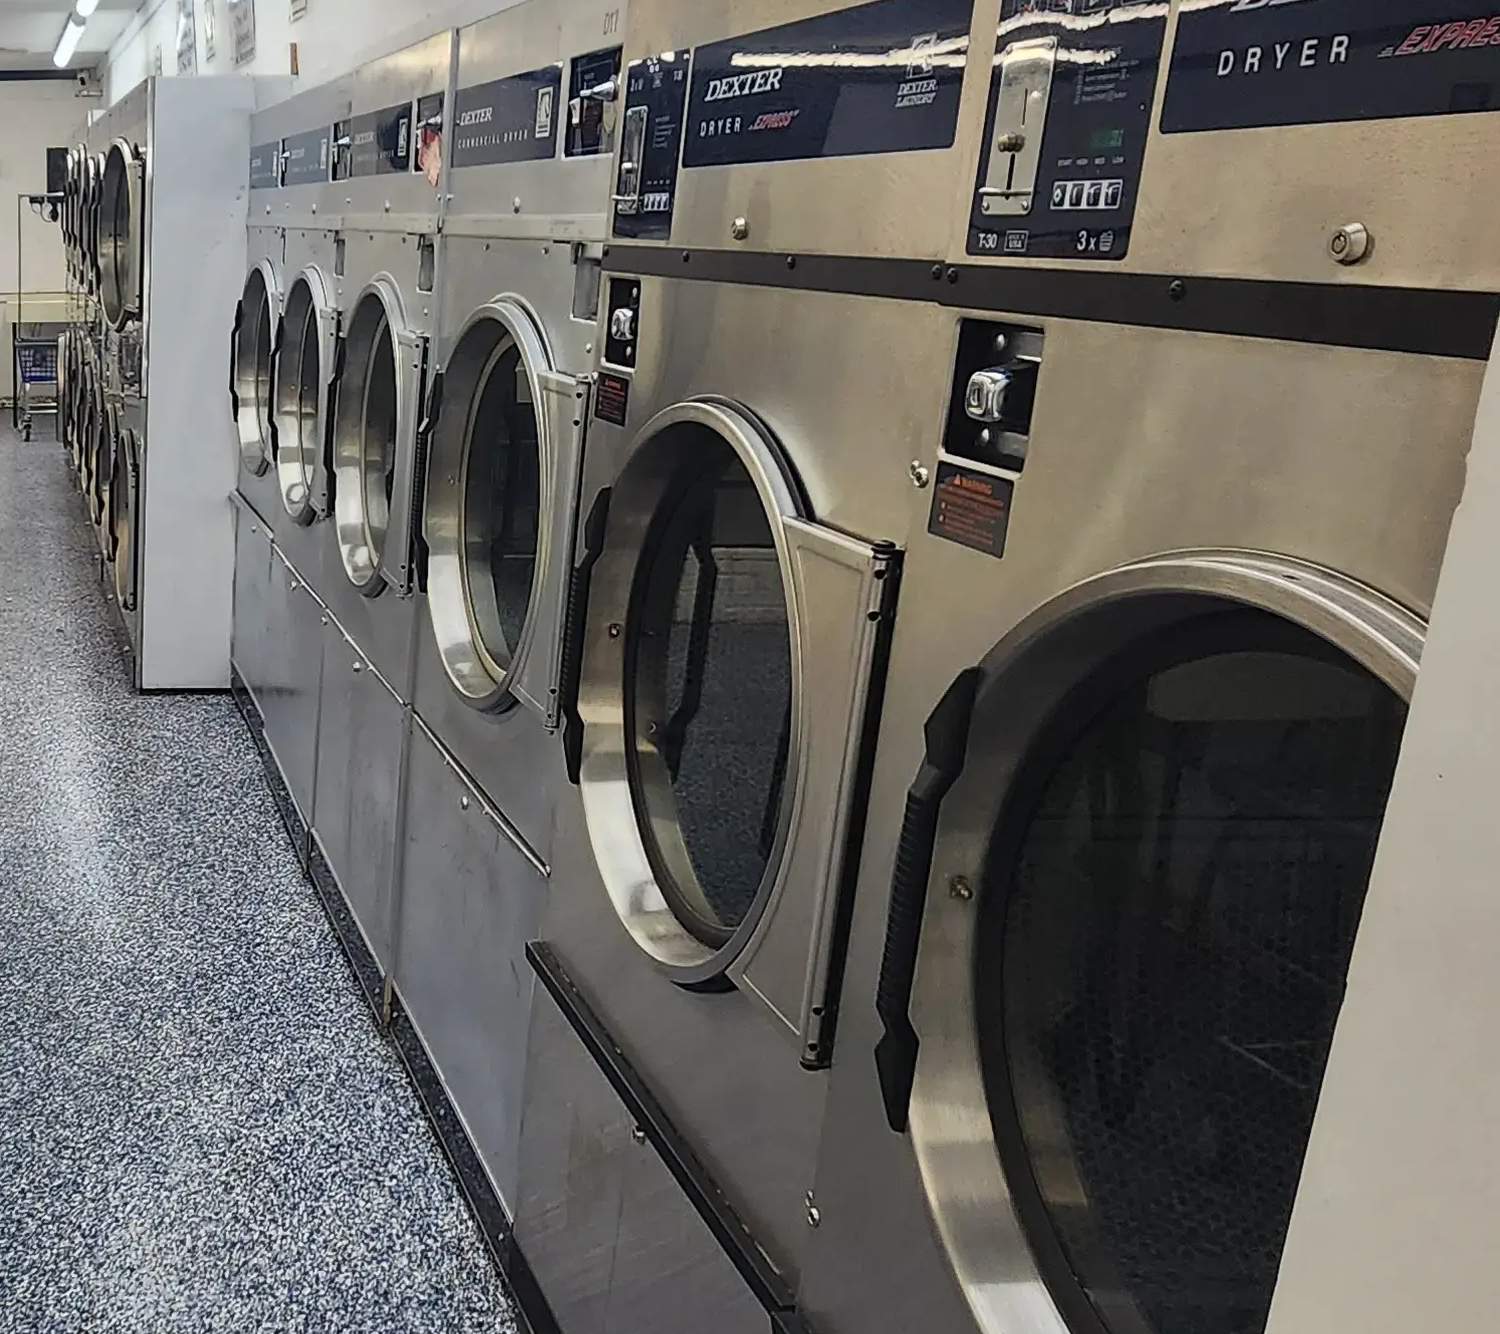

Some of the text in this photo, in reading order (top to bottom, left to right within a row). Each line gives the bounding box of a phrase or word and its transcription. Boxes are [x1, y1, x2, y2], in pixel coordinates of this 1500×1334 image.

[1216, 34, 1350, 77] DRYER
[703, 67, 782, 102] DEXTER
[897, 79, 938, 96] DEXTER
[460, 106, 494, 126] DEXTER
[700, 116, 741, 137] DRYER
[1076, 230, 1088, 252] 3
